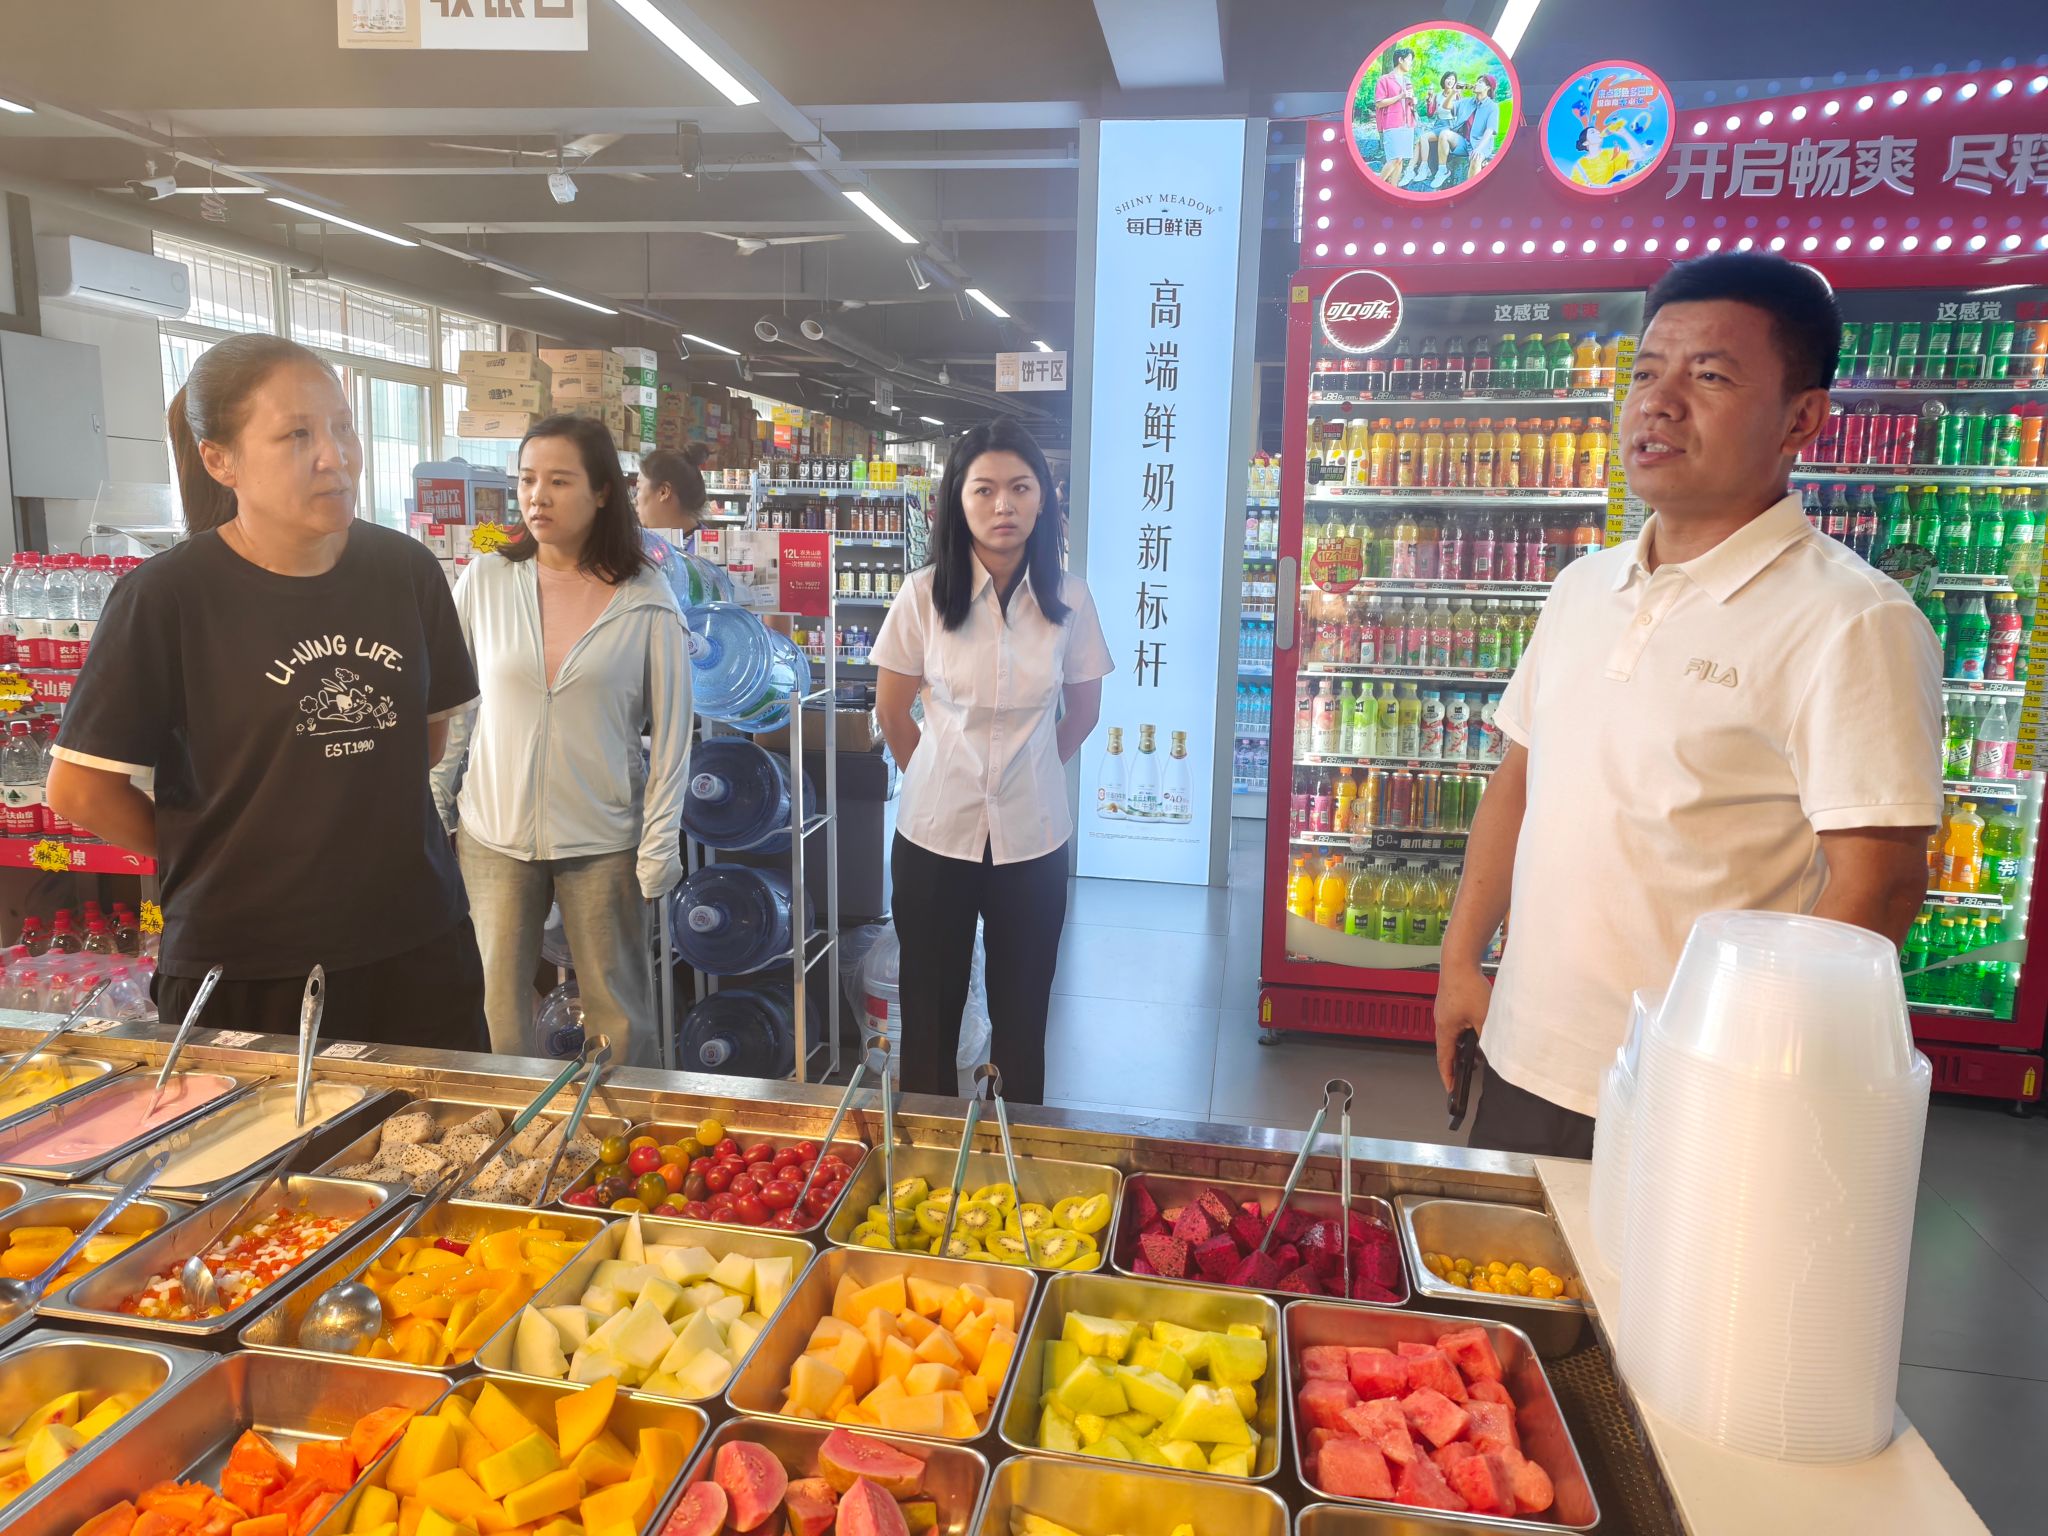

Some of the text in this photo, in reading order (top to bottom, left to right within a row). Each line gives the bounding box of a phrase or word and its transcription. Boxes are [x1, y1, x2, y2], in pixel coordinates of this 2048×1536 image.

[1666, 135, 1917, 200] 开启畅爽
[1115, 193, 1215, 216] SHINY MEADOW
[1126, 217, 1202, 237] 每日鲜语
[1326, 300, 1396, 321] 可口可乐
[1494, 303, 1550, 322] 这感觉
[1937, 302, 2002, 321] 这感觉
[1022, 360, 1063, 382] 饼干区
[1133, 278, 1184, 687] 高端鲜奶新标杆
[784, 549, 799, 559] 12L
[265, 635, 347, 685] LI-NING
[1683, 658, 1738, 688] FILA
